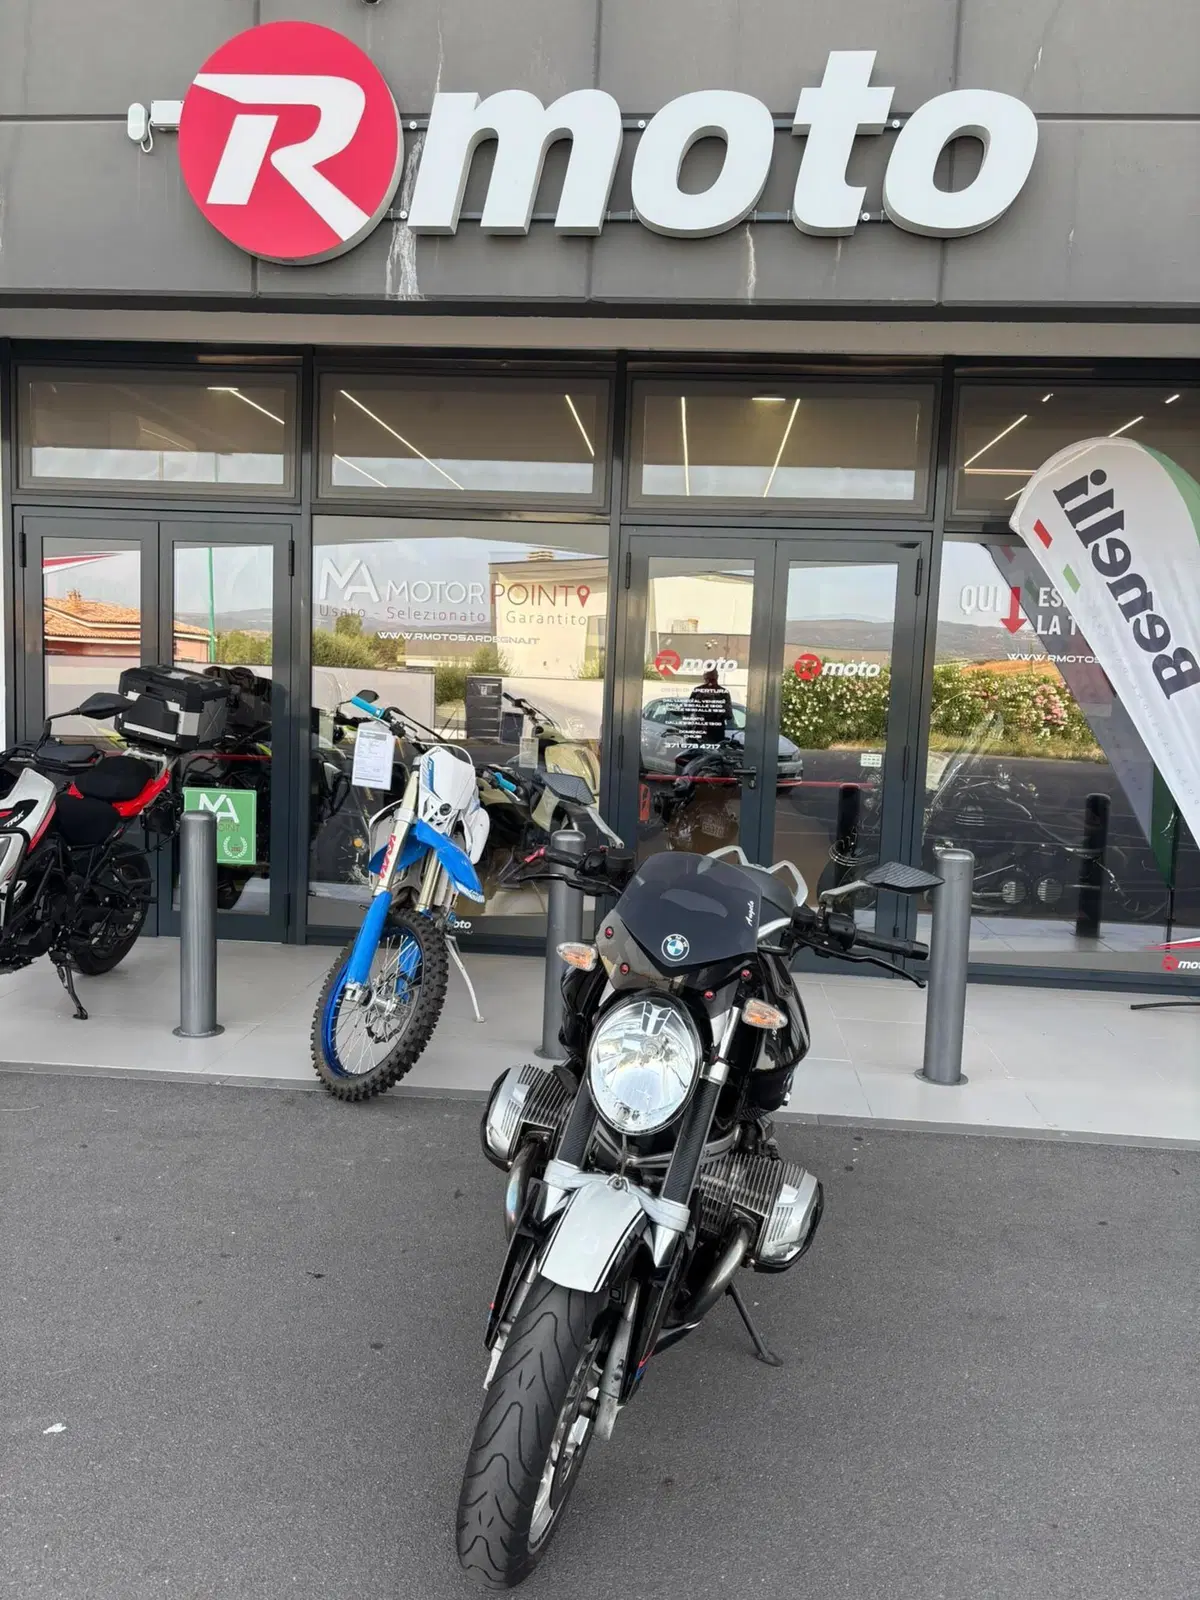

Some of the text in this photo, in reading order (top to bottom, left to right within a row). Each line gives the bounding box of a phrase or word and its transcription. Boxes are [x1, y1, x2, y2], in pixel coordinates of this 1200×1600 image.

[407, 50, 1040, 238] moto
[1053, 469, 1200, 699] Benelli
[960, 584, 1002, 615] QUI
[1038, 587, 1066, 608] ES
[319, 604, 367, 618] Usato
[386, 606, 487, 623] Selezionato
[506, 610, 588, 626] Garantito
[1037, 615, 1061, 635] LA
[682, 657, 739, 672] moto
[822, 660, 880, 677] moto
